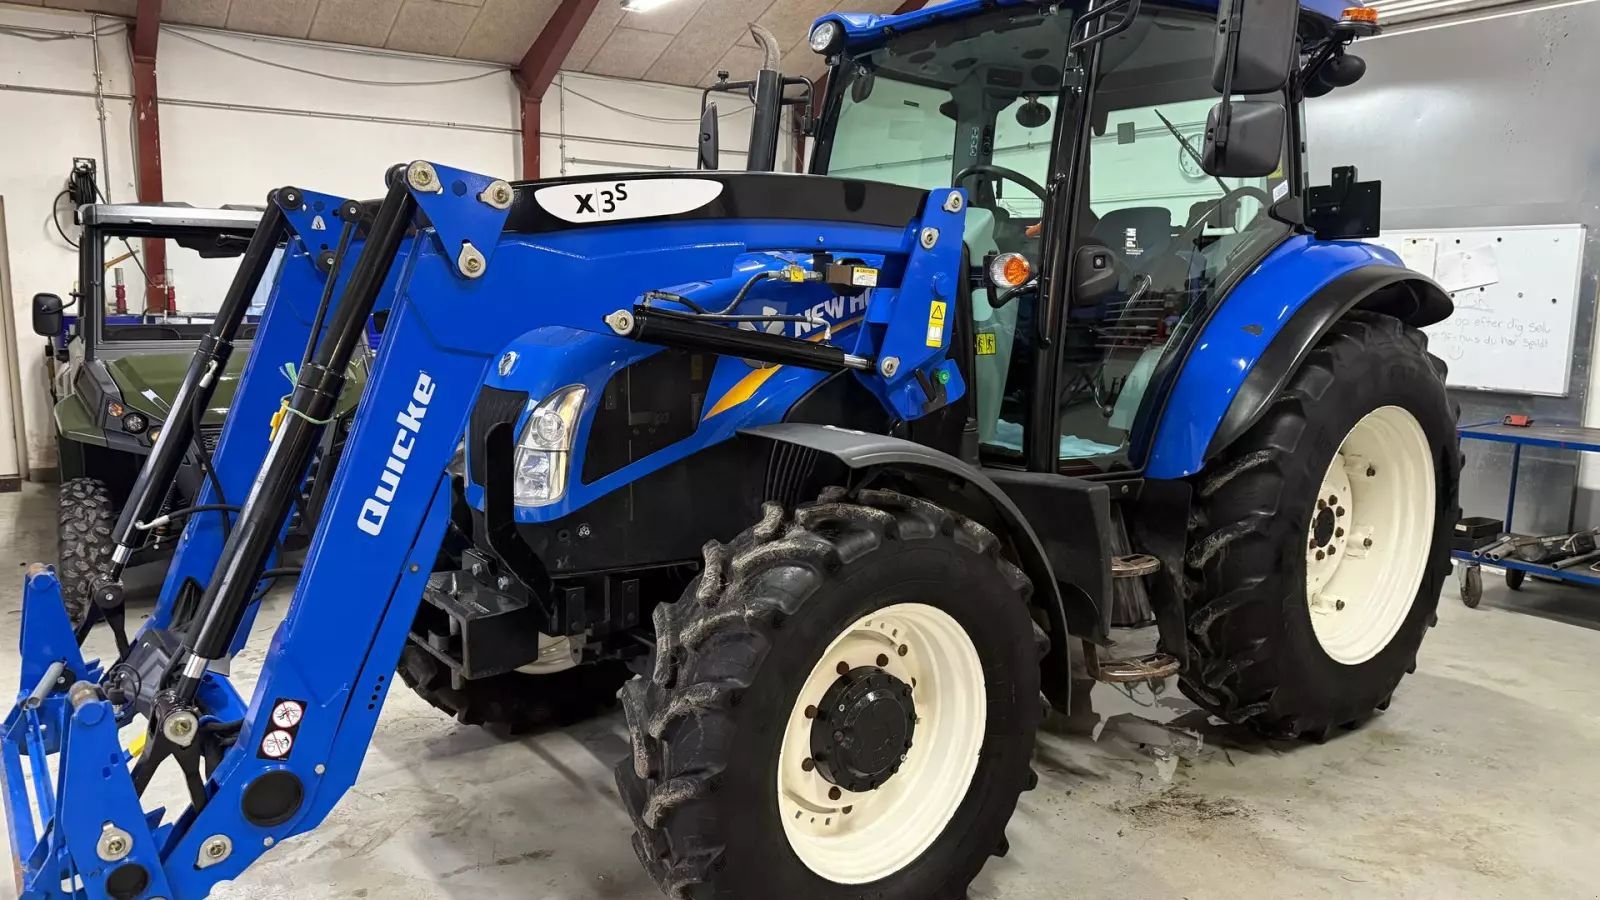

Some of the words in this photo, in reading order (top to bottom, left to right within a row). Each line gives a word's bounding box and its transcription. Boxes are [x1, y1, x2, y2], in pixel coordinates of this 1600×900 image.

[794, 296, 845, 338] NEW
[1474, 316, 1502, 328] efter
[1507, 317, 1524, 336] dig
[1484, 335, 1497, 346] du
[357, 372, 436, 536] Quicke
